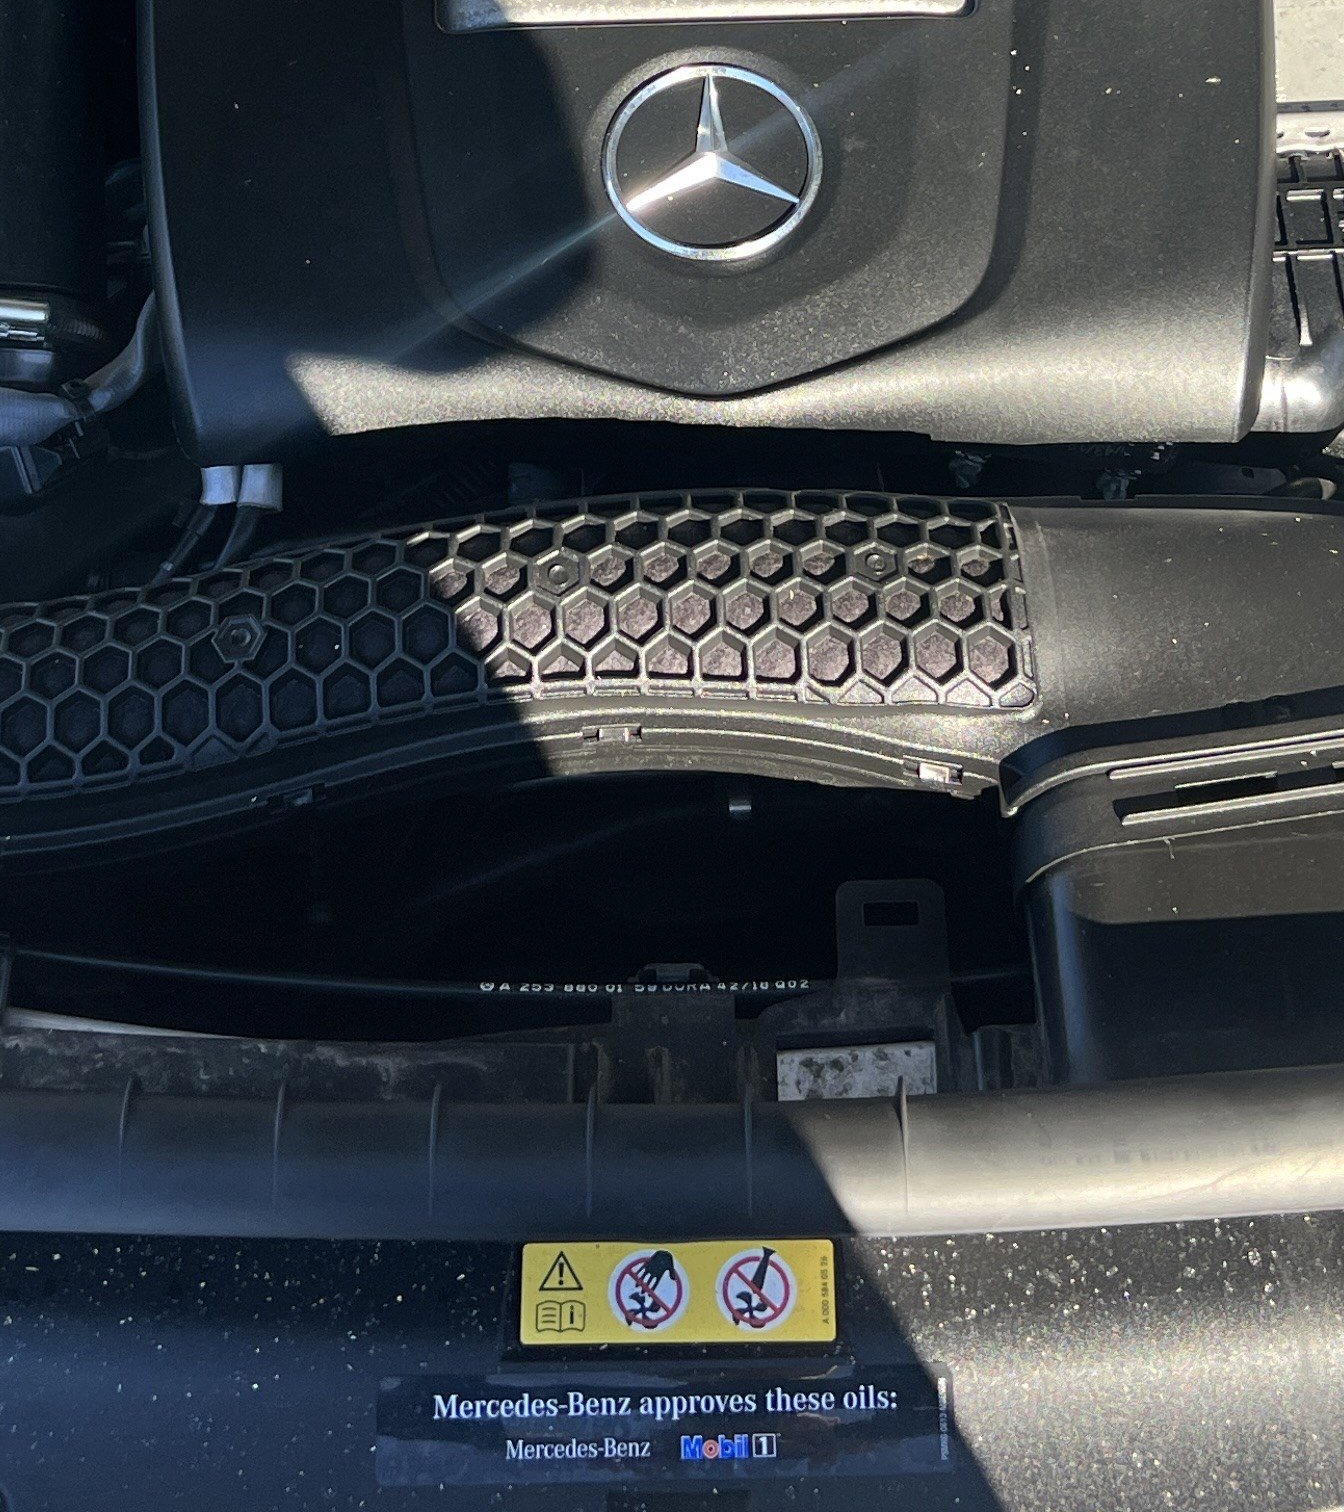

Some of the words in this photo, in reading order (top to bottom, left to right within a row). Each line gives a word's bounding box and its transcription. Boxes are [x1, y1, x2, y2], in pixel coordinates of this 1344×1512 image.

[433, 1391, 631, 1419] Mercedes-Benz
[640, 1392, 756, 1421] approves
[765, 1386, 835, 1412] these
[843, 1384, 897, 1410] oils:
[506, 1436, 651, 1460] Mercedes-Benz
[681, 1434, 749, 1460] Mobil
[755, 1435, 774, 1456] 1
